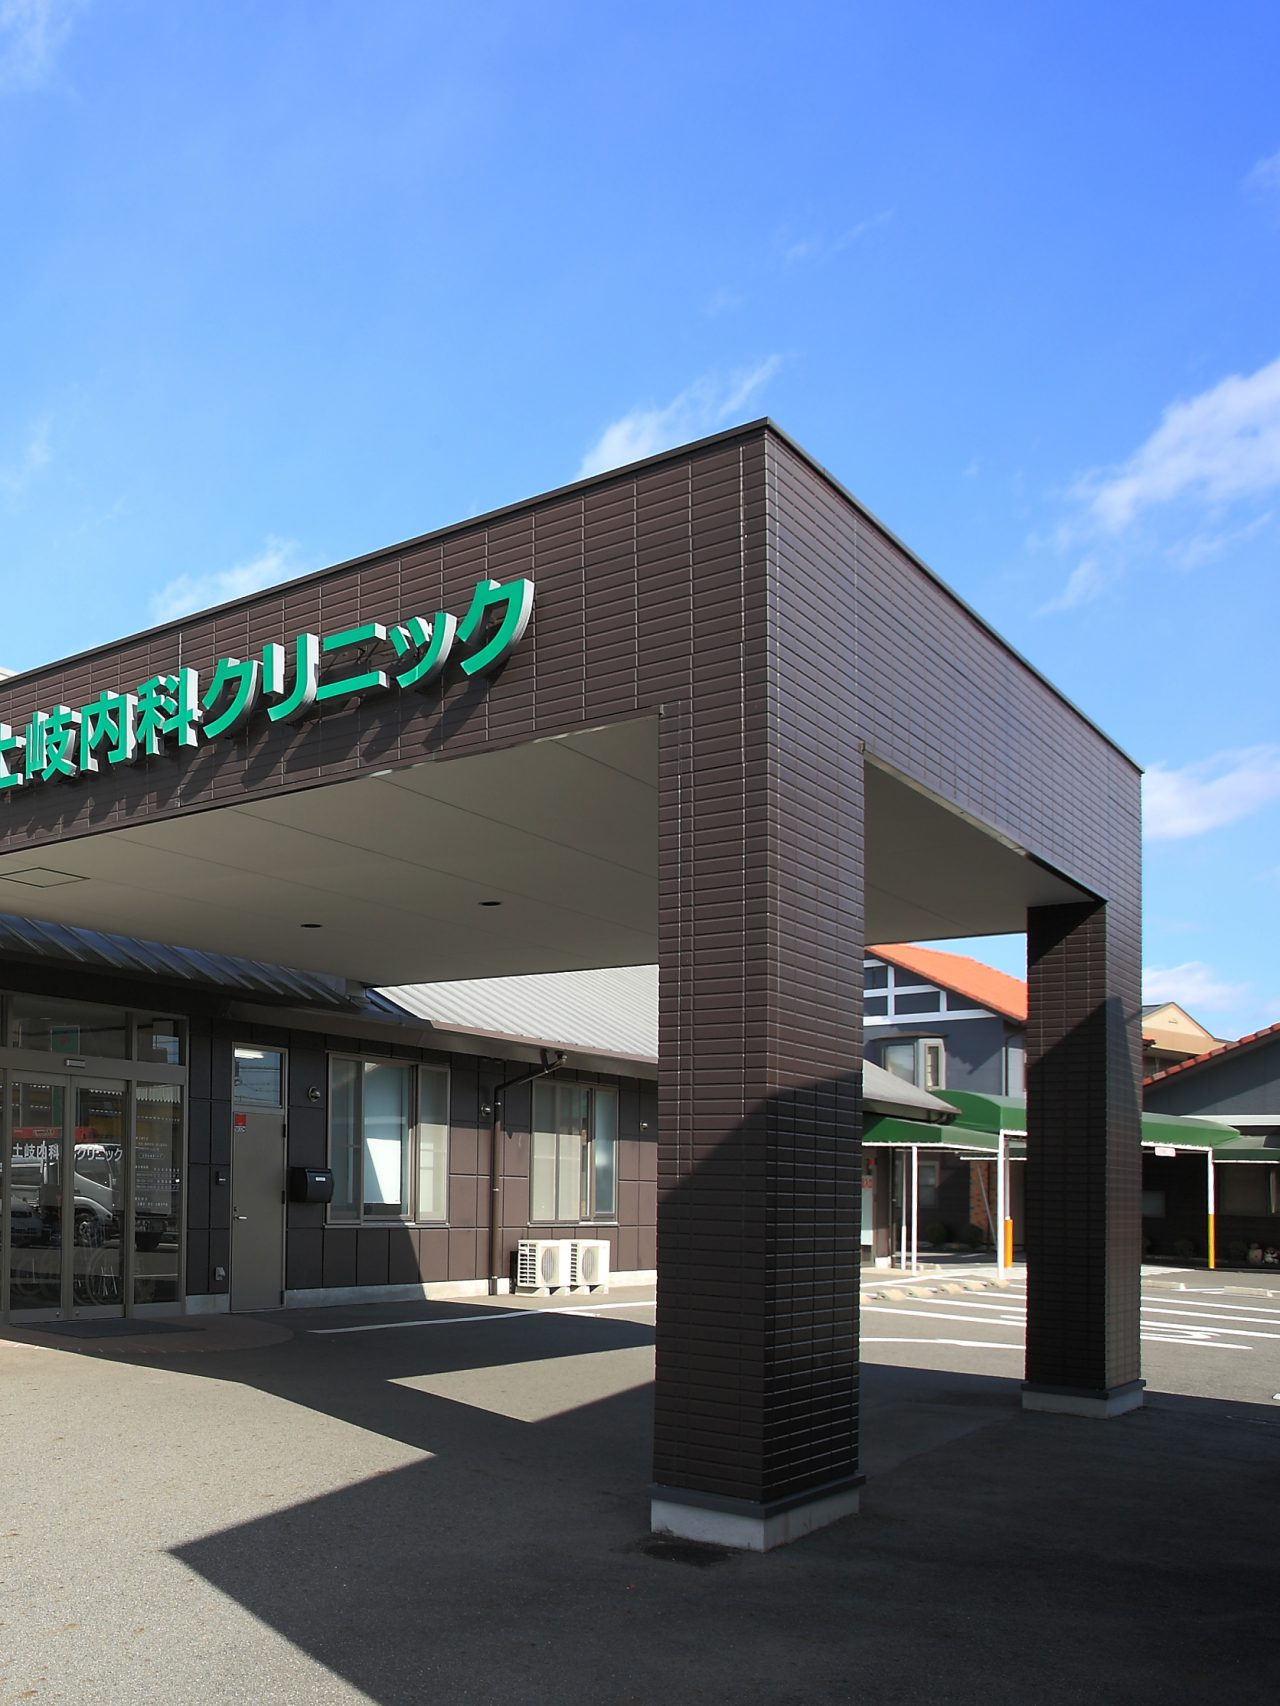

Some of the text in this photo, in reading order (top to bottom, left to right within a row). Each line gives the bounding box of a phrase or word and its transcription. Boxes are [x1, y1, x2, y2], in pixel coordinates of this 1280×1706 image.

[12, 1143, 123, 1162] 土岐内科 クリニック
